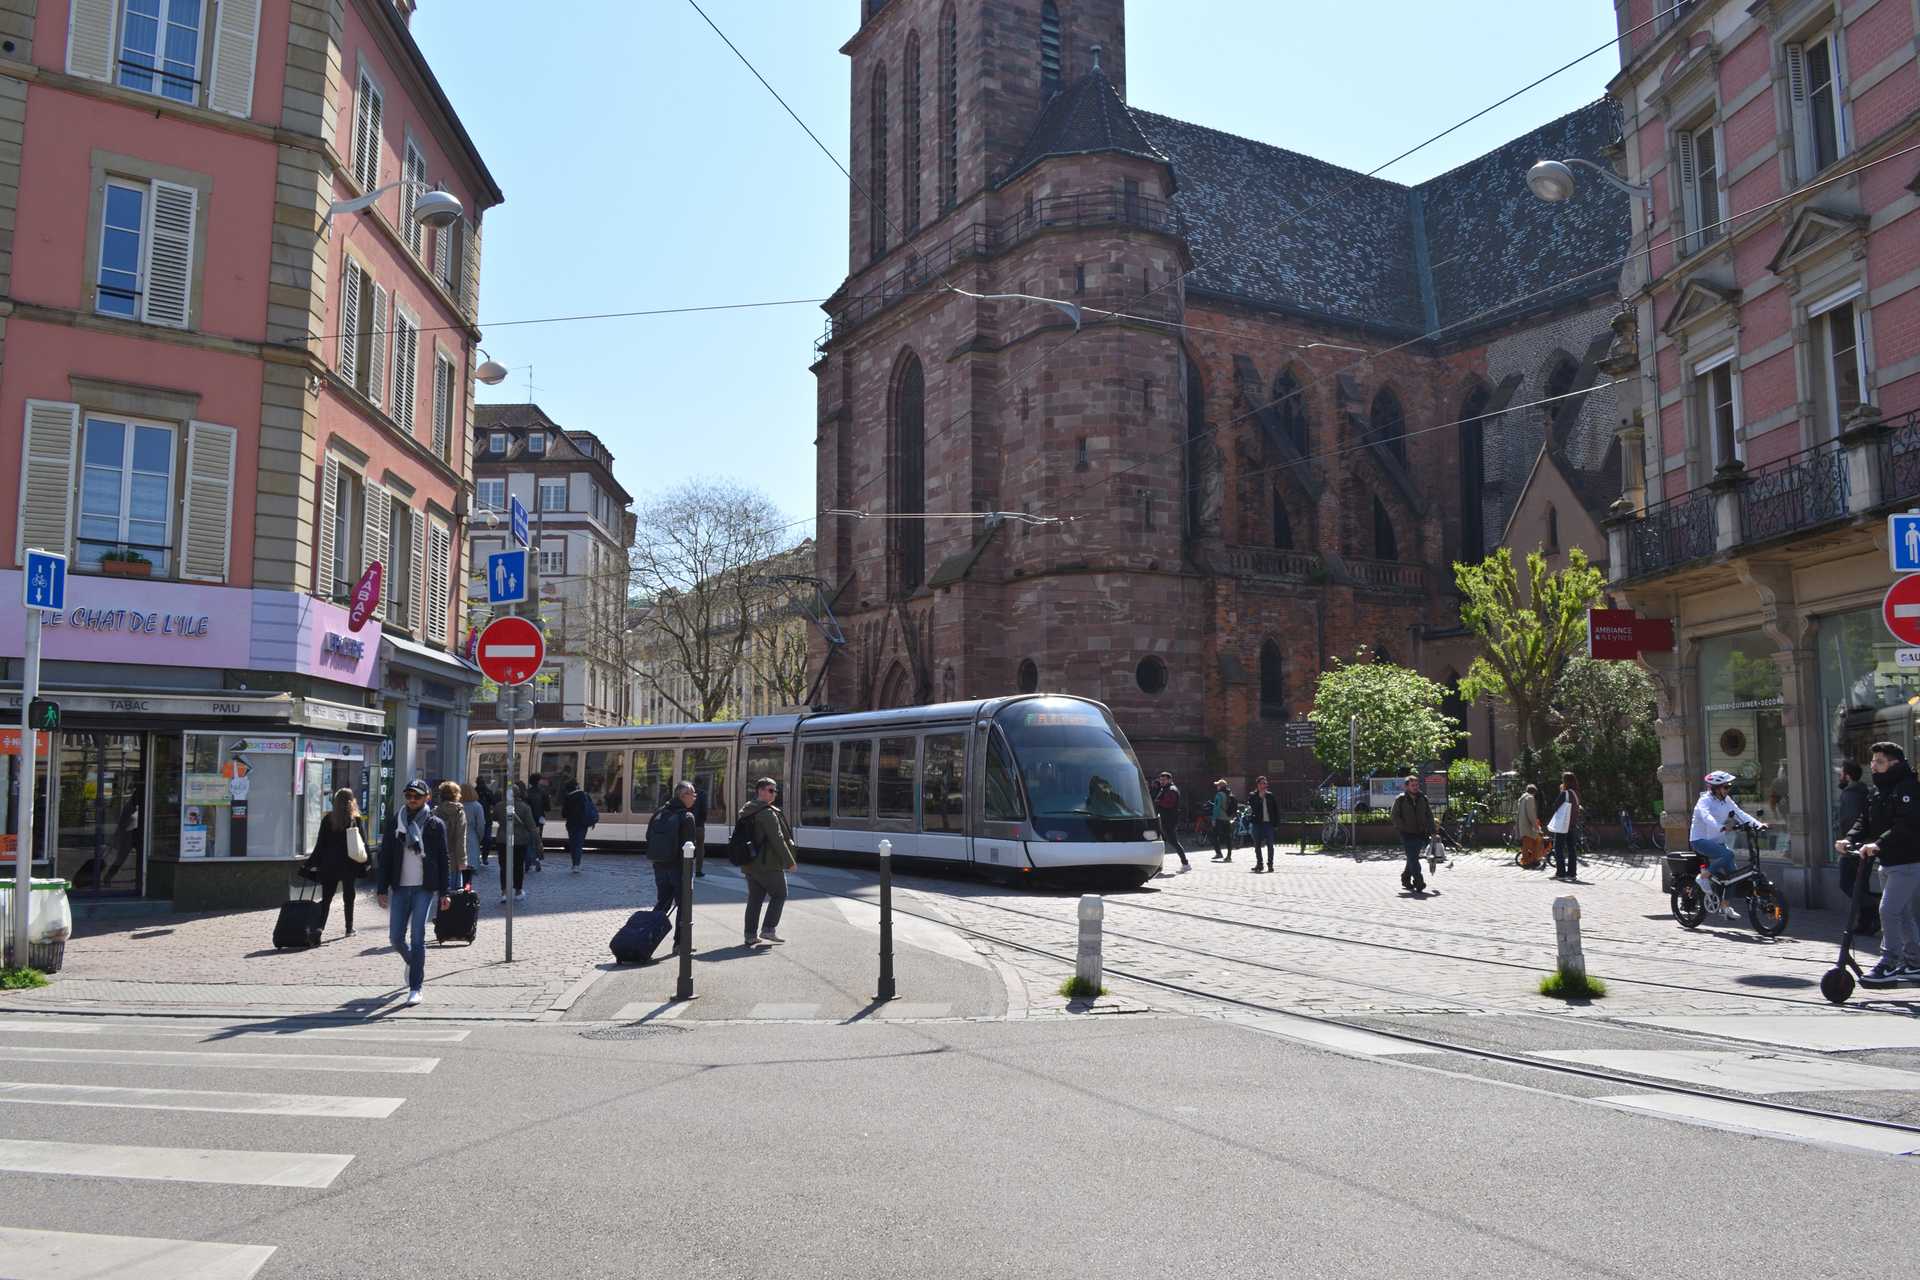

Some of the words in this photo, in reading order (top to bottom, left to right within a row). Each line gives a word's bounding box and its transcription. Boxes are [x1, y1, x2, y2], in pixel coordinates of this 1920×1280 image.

[352, 570, 378, 622] TABAC
[41, 610, 64, 627] LE
[71, 608, 127, 632] CHAT
[130, 611, 158, 634] DE
[1595, 627, 1633, 635] AMBIANCE
[110, 700, 149, 711] TABAC
[212, 703, 241, 714] PMU
